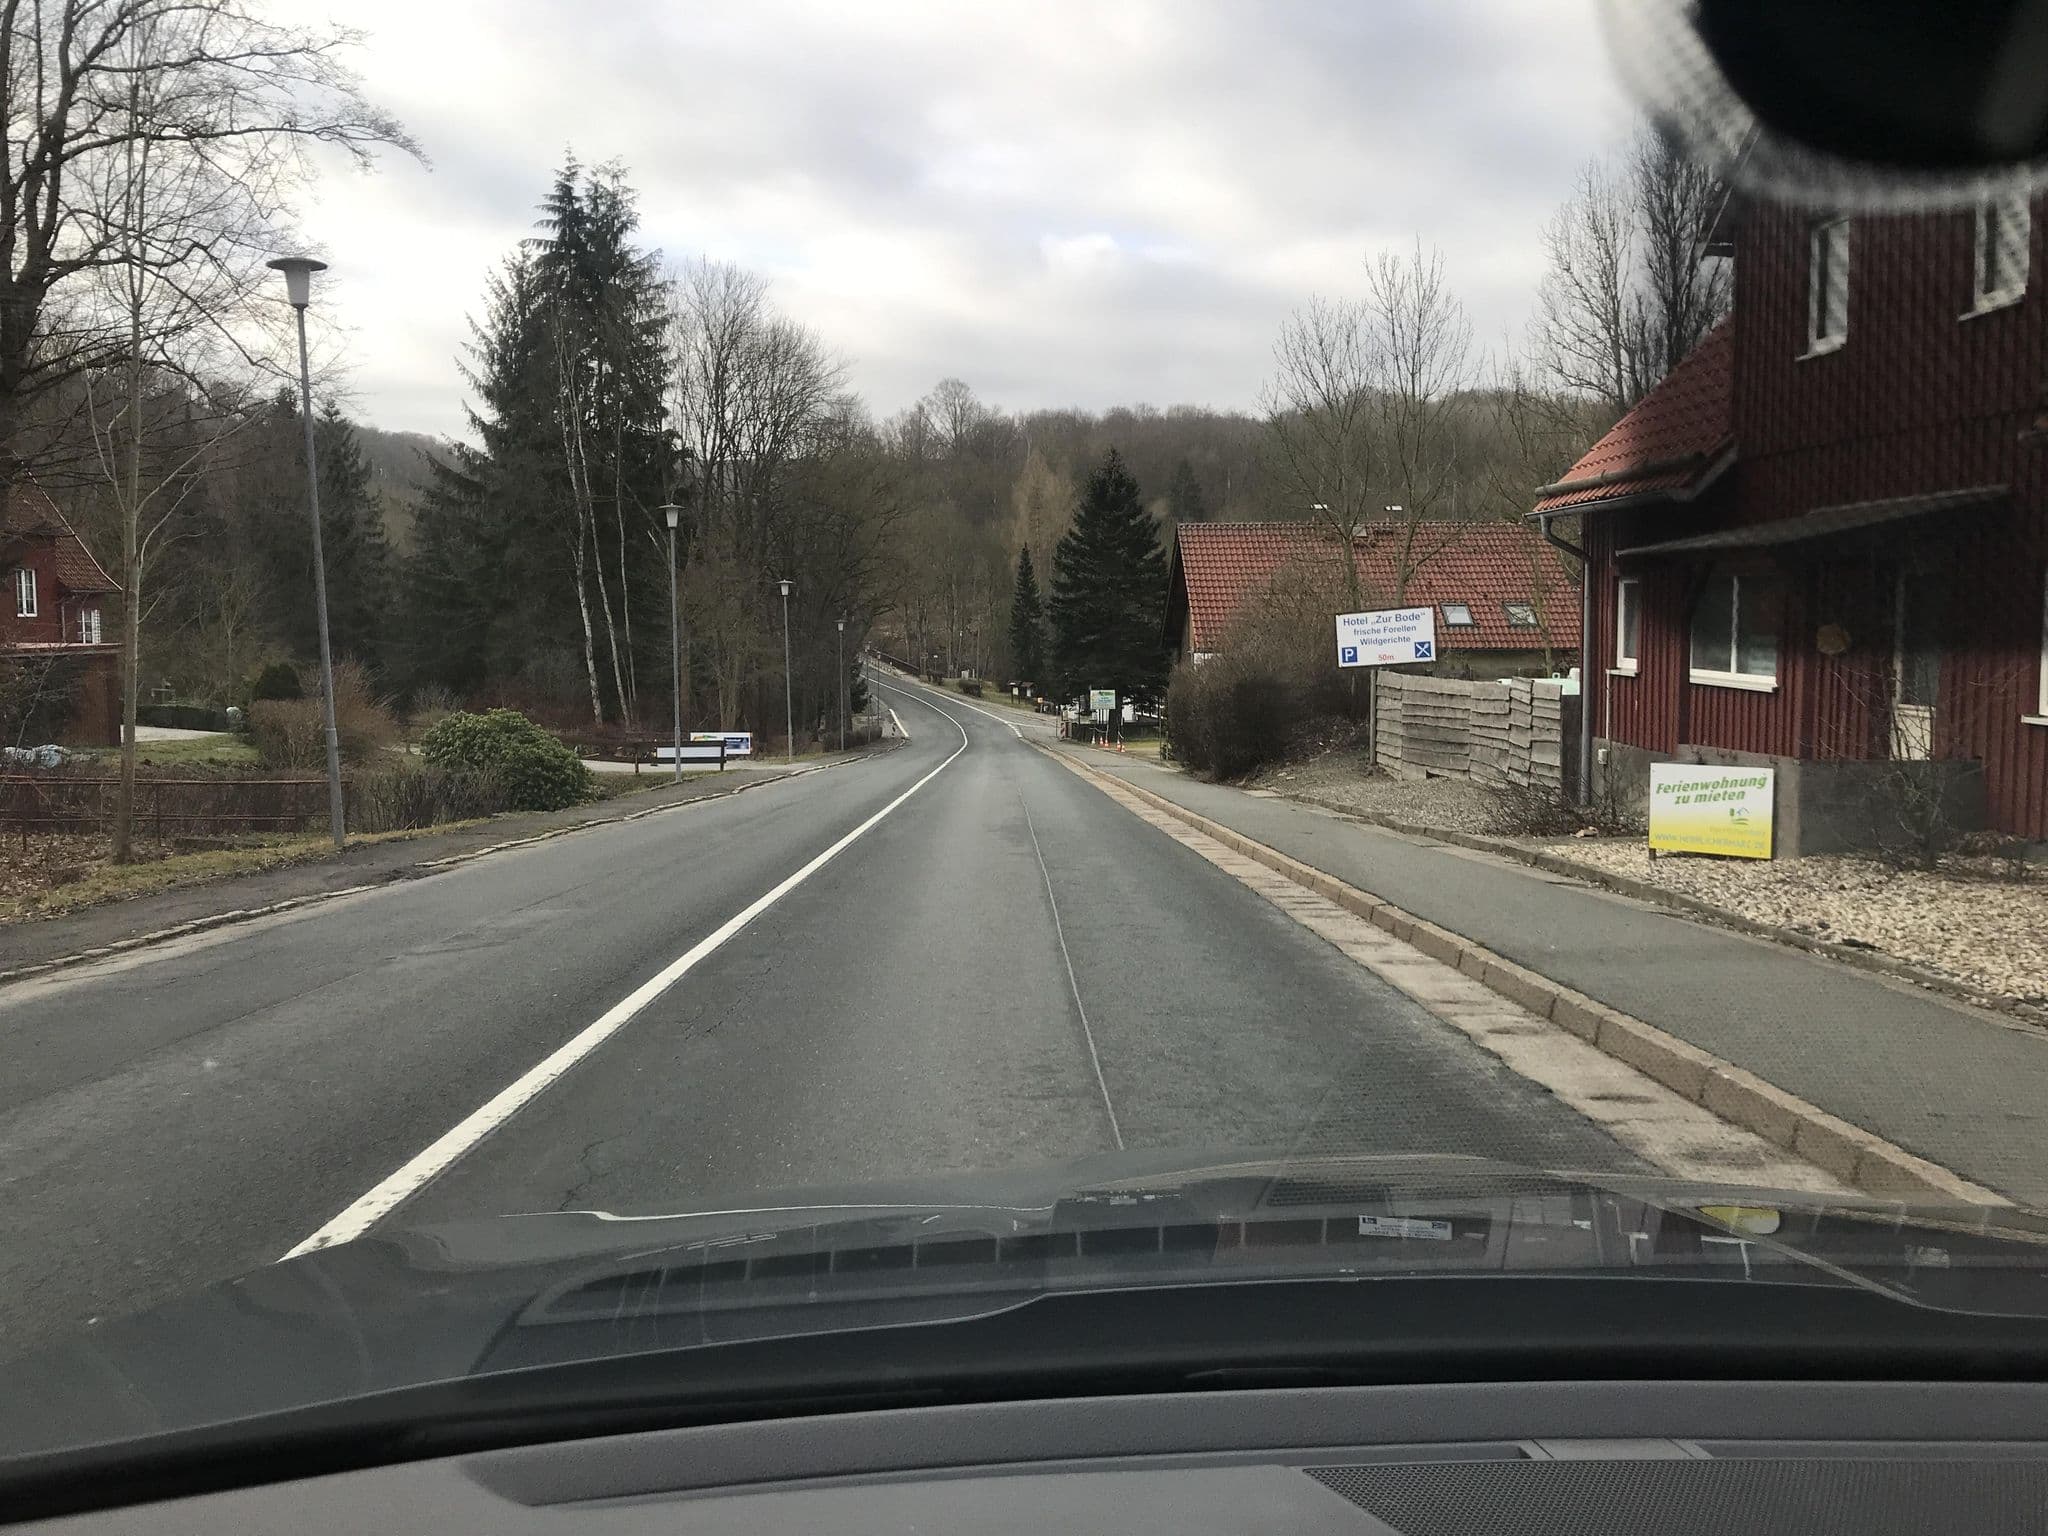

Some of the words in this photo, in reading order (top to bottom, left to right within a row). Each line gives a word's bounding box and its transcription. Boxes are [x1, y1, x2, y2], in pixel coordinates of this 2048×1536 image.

[1343, 617, 1368, 627] Hotel
[1354, 626, 1381, 636] frische
[1383, 624, 1417, 634] Forellen
[1359, 635, 1411, 647] Wildgerichte
[1345, 648, 1354, 662] P
[1656, 775, 1767, 795] Ferienwohnung
[1674, 795, 1690, 805] zu
[1694, 790, 1746, 804] mieten
